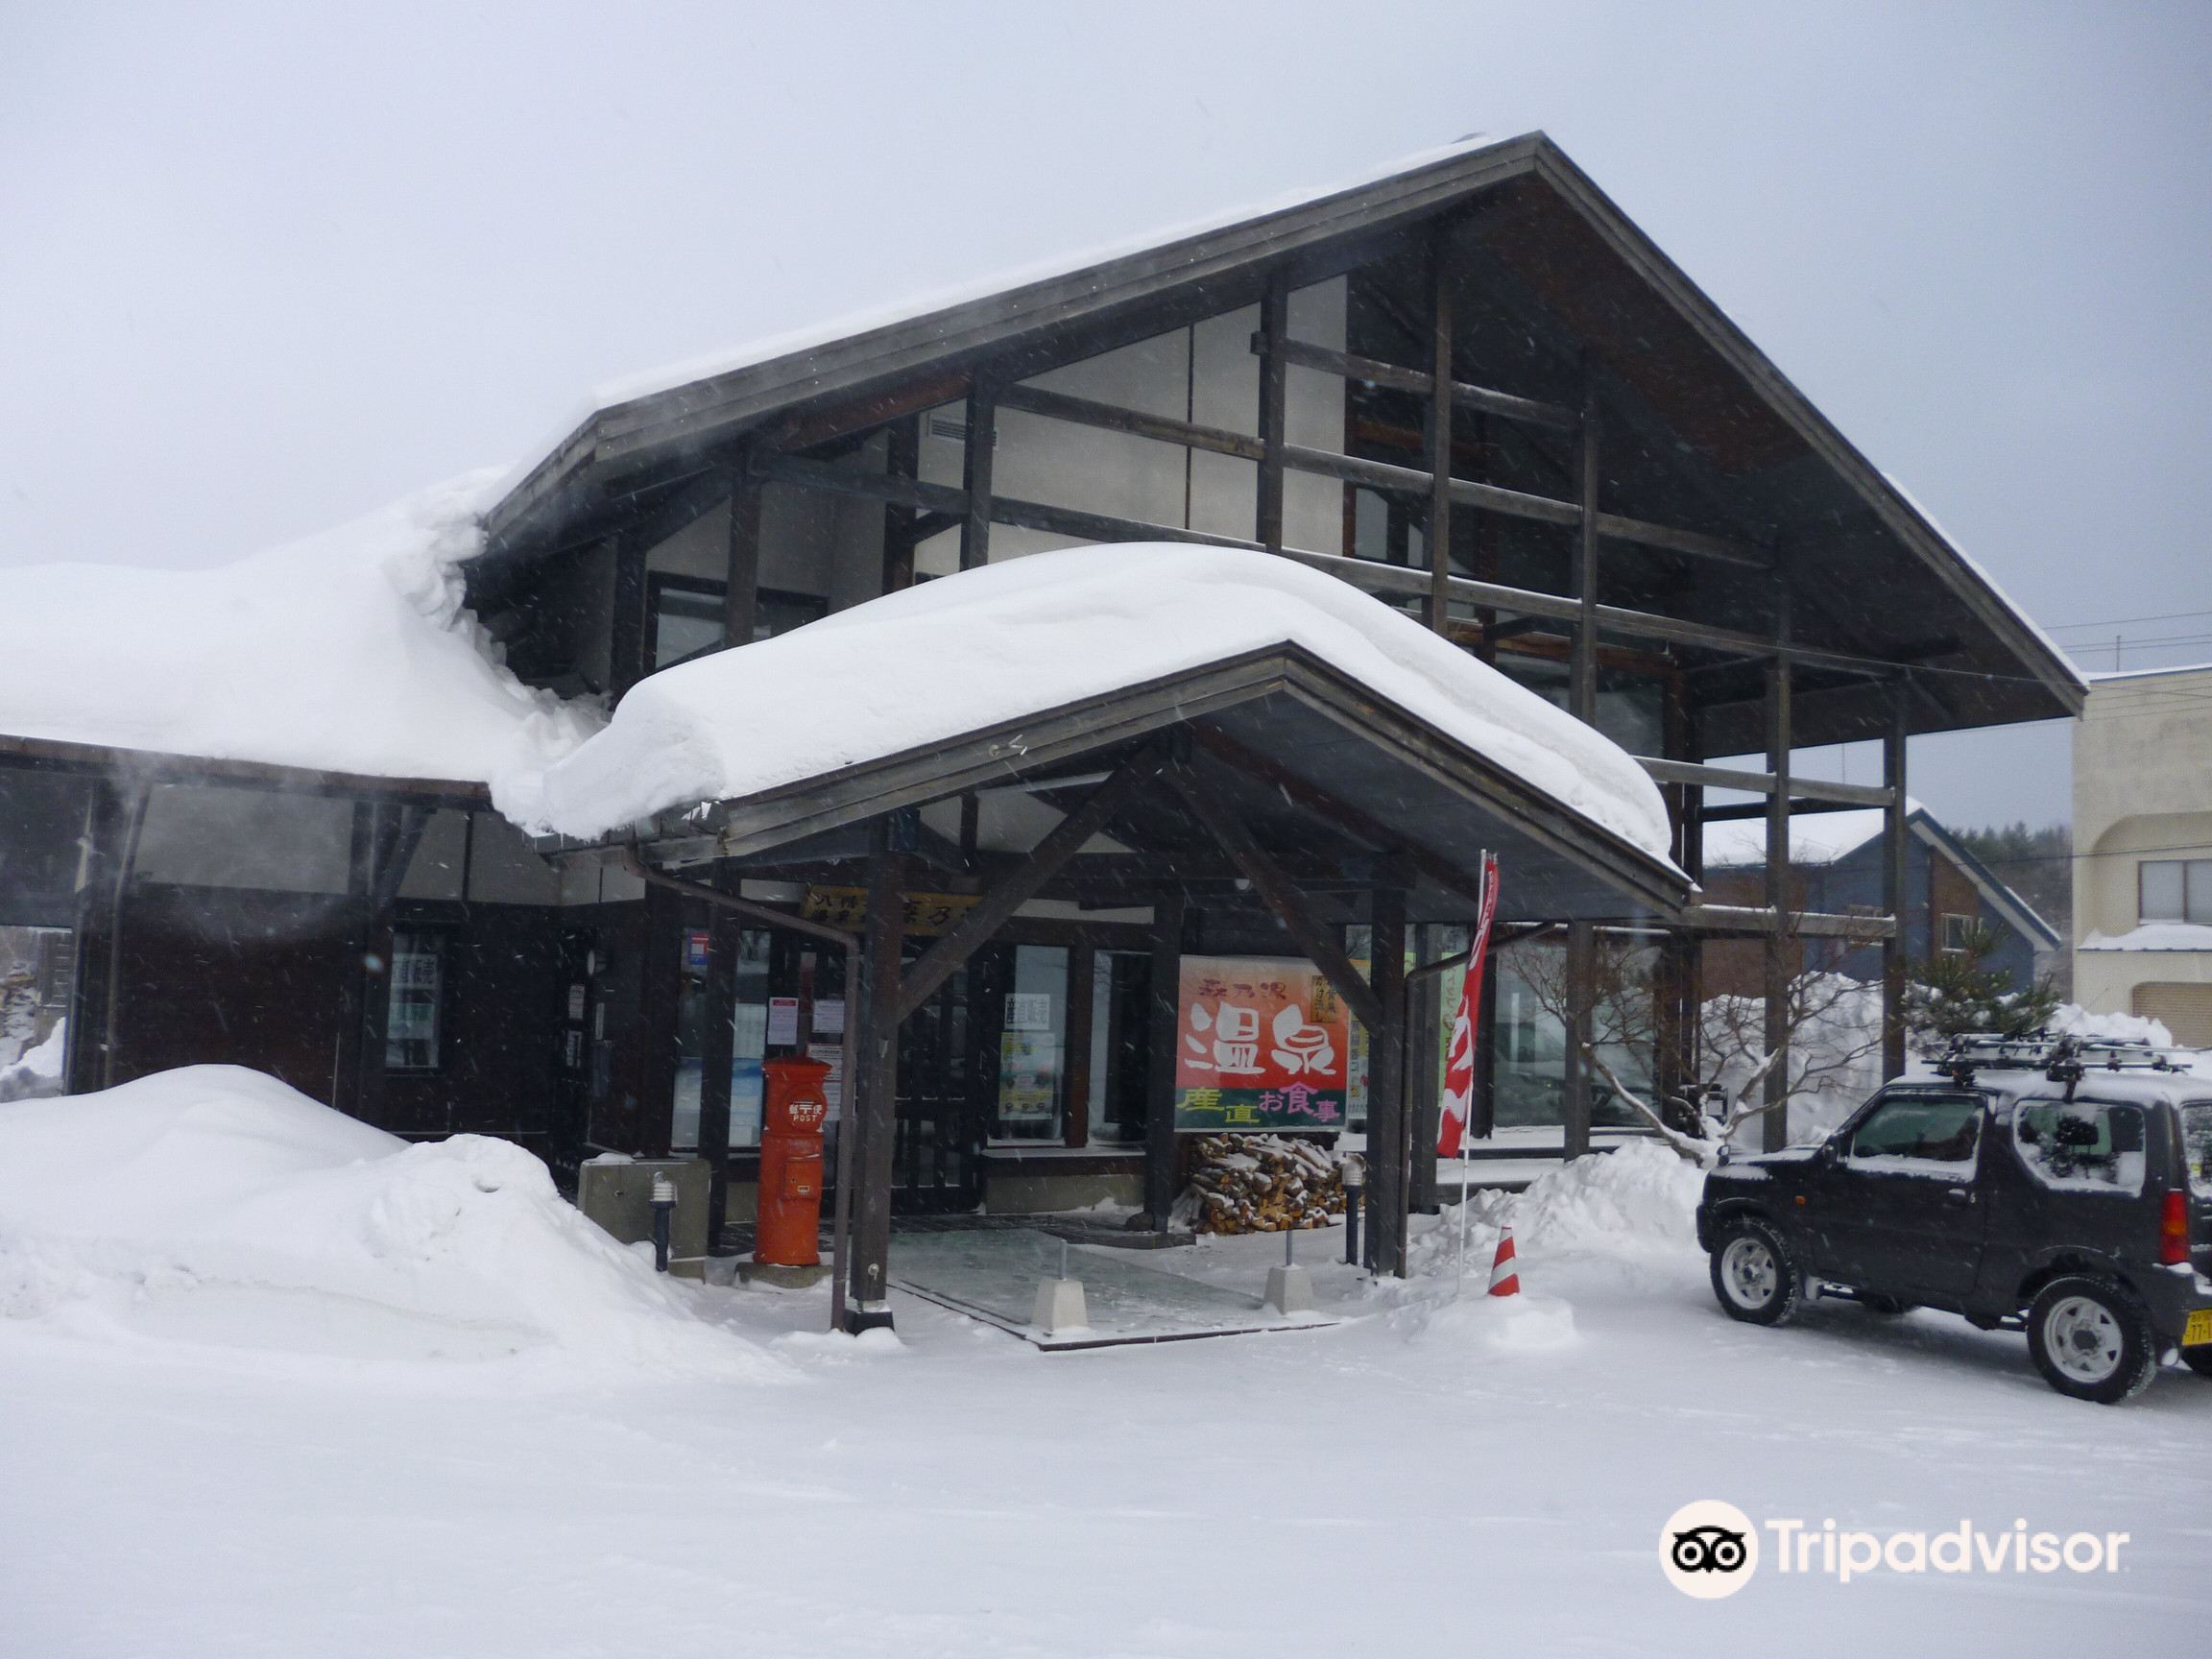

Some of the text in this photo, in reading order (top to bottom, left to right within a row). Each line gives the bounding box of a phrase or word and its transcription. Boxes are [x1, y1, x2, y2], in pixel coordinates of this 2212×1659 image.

[1184, 1000, 1337, 1076] 温泉
[1176, 1081, 1341, 1124] 産直 お食事
